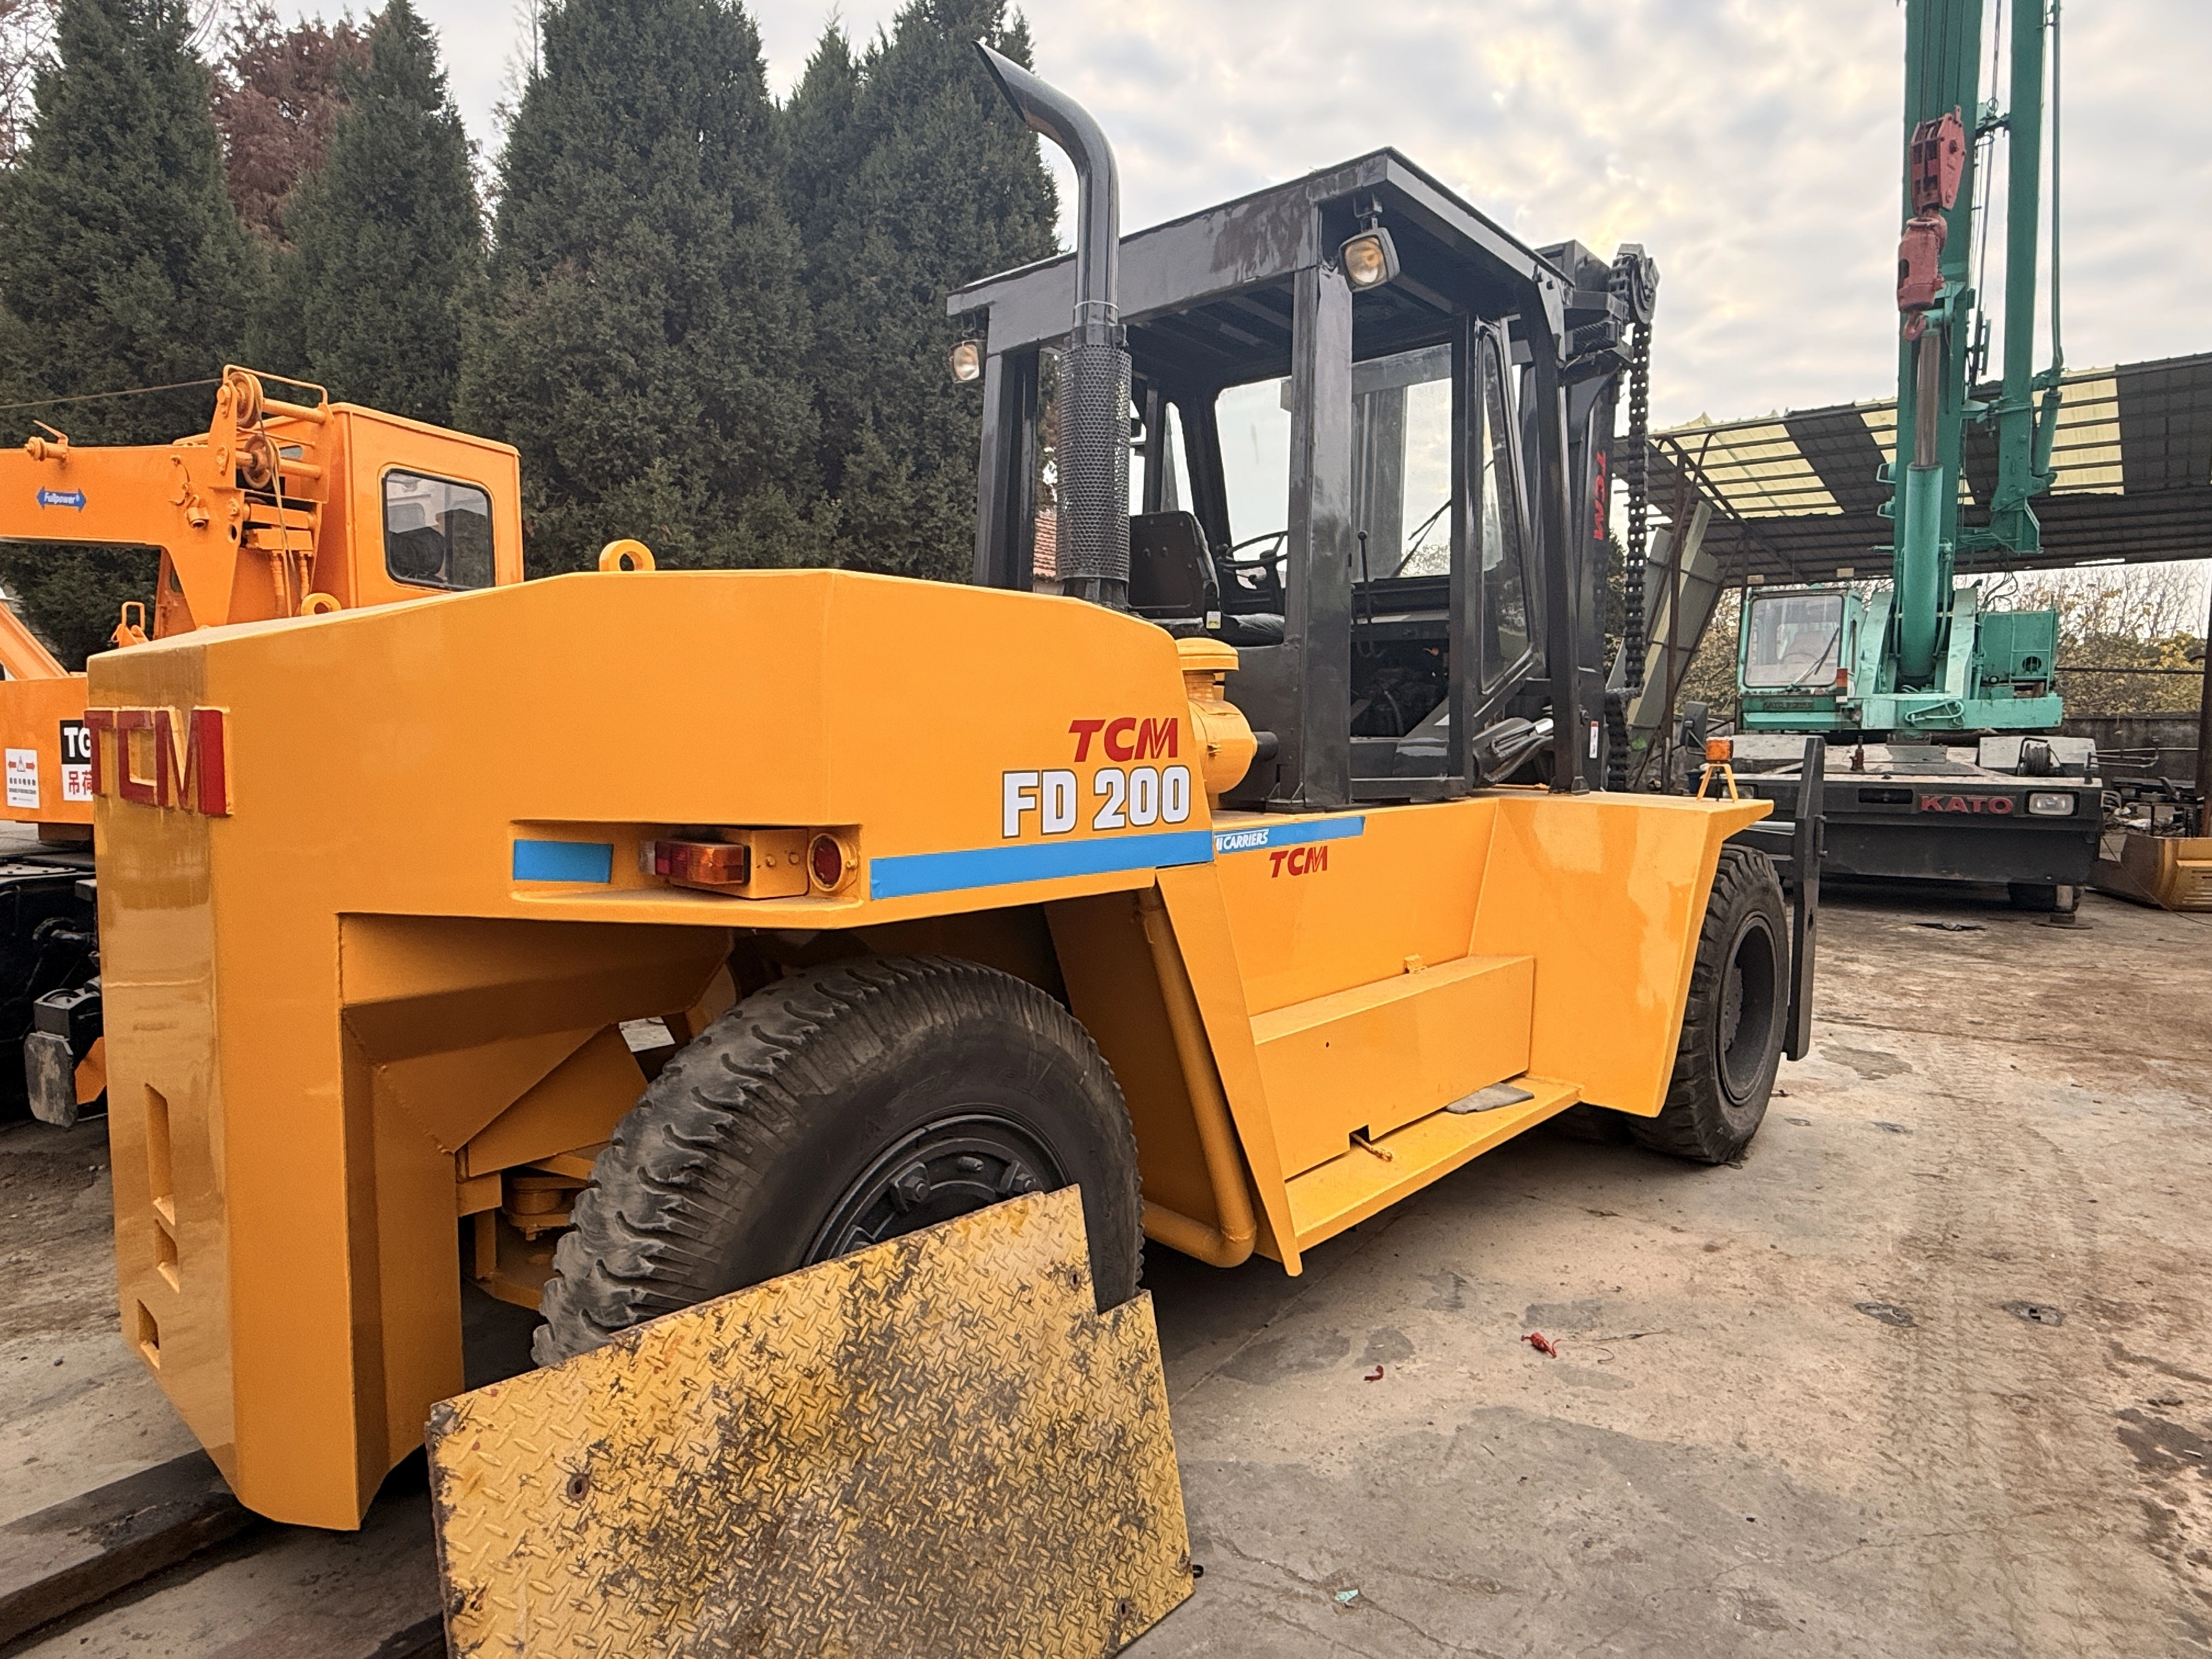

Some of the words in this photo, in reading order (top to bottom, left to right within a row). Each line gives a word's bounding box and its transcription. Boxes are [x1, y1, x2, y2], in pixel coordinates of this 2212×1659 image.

[1593, 449, 1606, 540] TCM
[1068, 718, 1178, 762] TCM
[83, 709, 229, 817] TCM
[1002, 769, 1077, 838] FD
[1092, 765, 1192, 831] 200
[1921, 796, 2014, 814] KATO
[1223, 831, 1268, 850] CARRIERS
[1269, 845, 1328, 878] TCM
